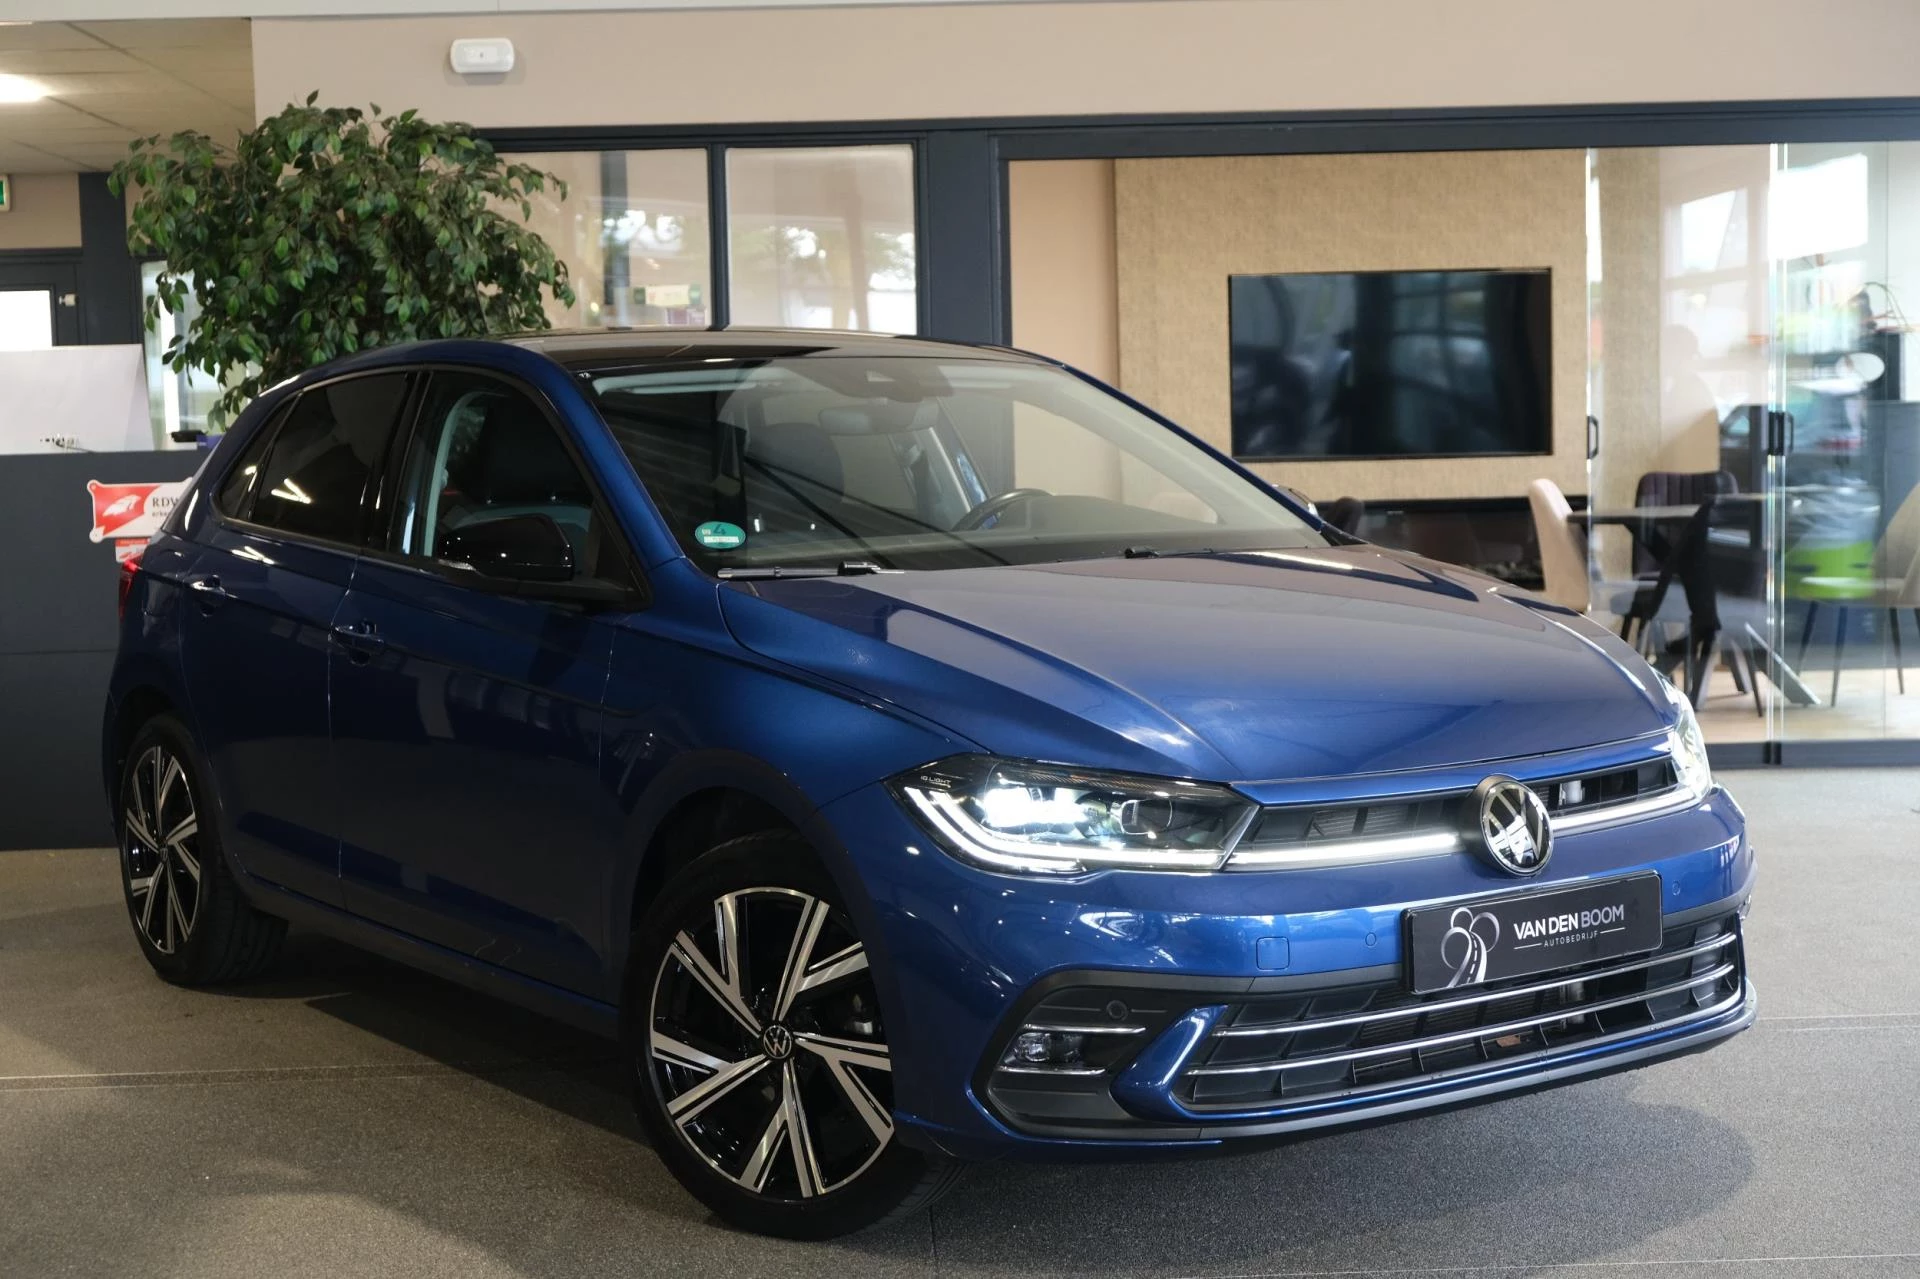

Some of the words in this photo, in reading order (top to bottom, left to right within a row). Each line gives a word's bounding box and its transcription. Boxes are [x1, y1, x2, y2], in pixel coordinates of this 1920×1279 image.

[1513, 920, 1546, 940] VAN
[1548, 912, 1579, 935] DEN
[1581, 904, 1625, 928] BOOM
[1544, 930, 1598, 948] AUTOBEDRIJF
